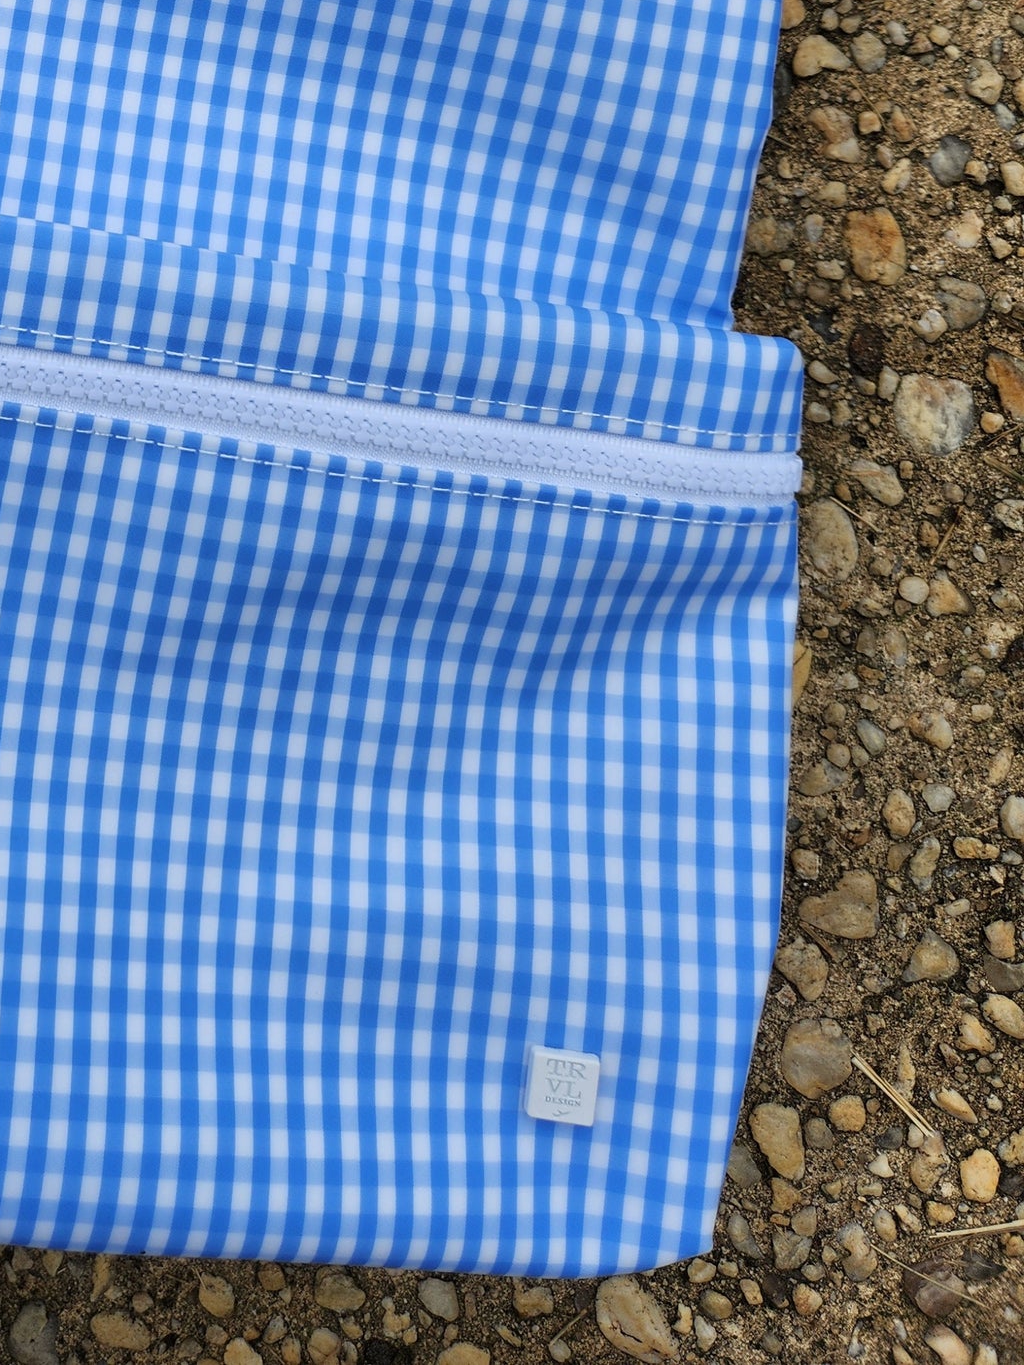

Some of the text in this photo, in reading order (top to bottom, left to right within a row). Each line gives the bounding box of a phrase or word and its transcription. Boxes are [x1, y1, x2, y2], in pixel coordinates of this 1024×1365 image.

[546, 1058, 587, 1080] TR
[545, 1077, 582, 1099] VL
[545, 1096, 582, 1107] DESIGN
